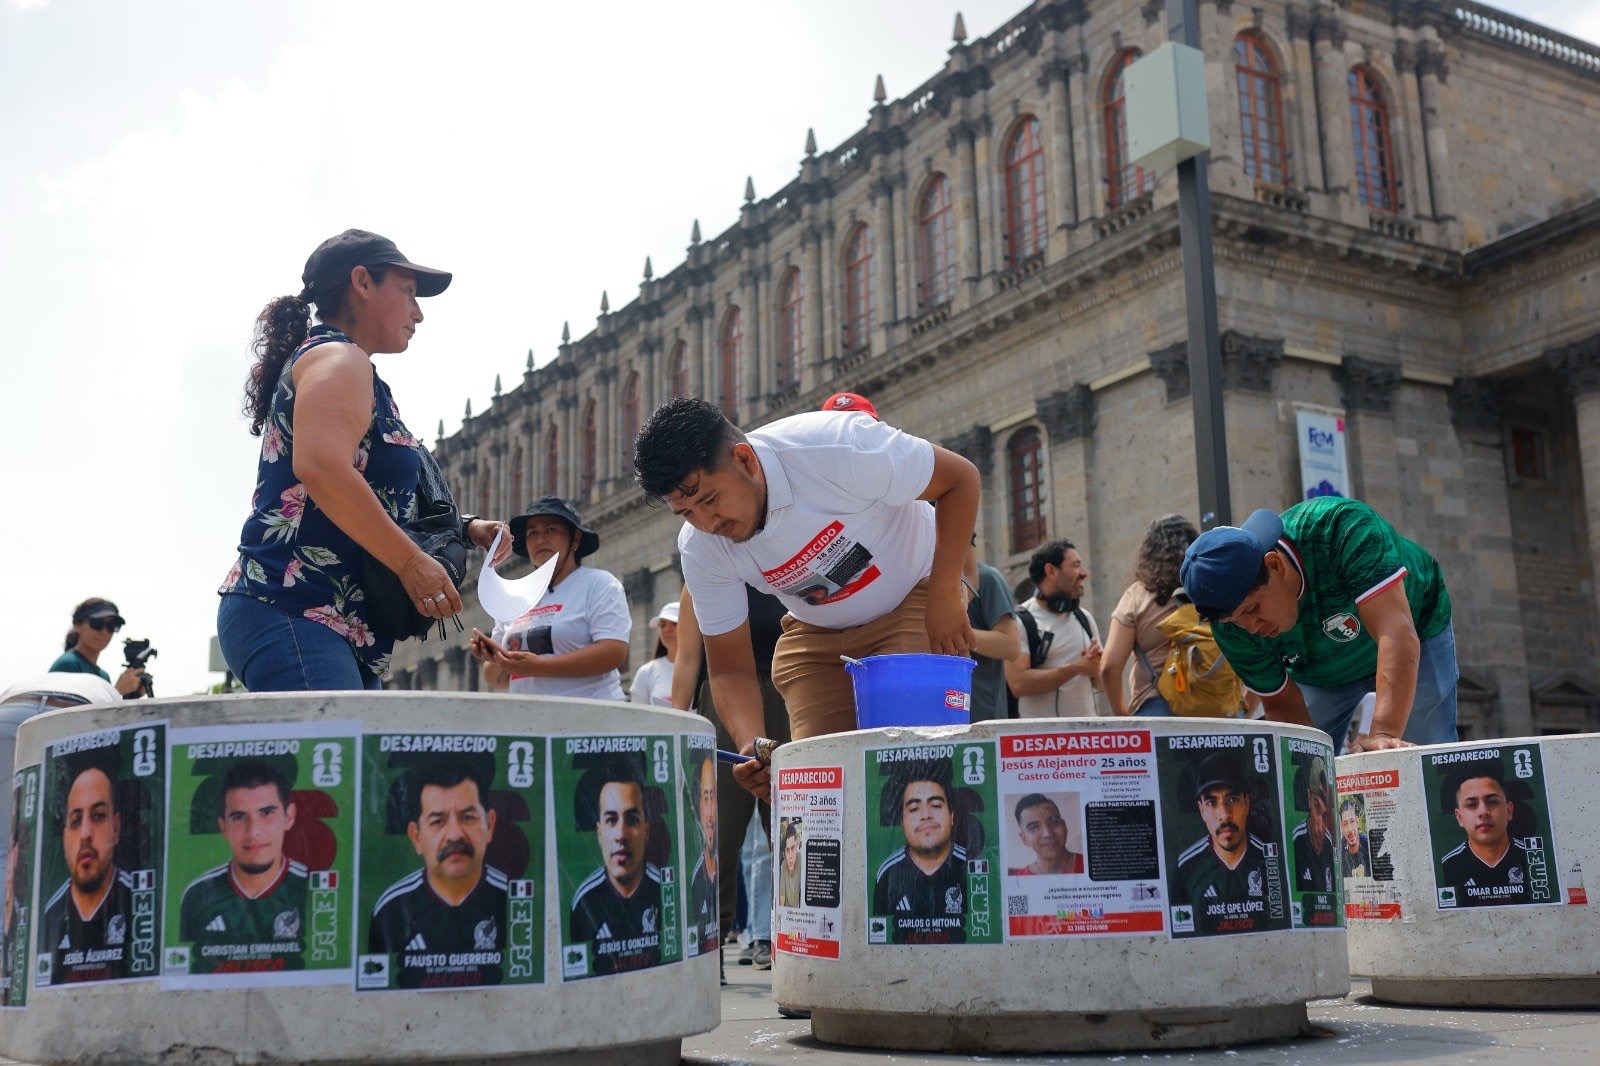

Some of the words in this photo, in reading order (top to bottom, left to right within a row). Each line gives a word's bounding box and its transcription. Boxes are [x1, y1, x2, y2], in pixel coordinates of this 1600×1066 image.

[764, 527, 837, 583] DESAPARECIDO
[817, 552, 828, 561] 18
[827, 535, 846, 553] años
[52, 731, 121, 758] DESAPARECIDO
[187, 740, 299, 760] DESAPARECIDO
[380, 736, 497, 753] DESAPARECIDO
[565, 736, 647, 754] DESAPARECIDO
[1012, 735, 1142, 752] DESAPARECIDO
[1169, 735, 1245, 750] DESAPARECIDO
[876, 744, 954, 763] DESAPARECIDO
[1431, 749, 1500, 765] DESAPARECIDO
[1001, 758, 1034, 773] Jesús
[1037, 756, 1097, 770] Alejandro
[1101, 758, 1115, 767] 25
[1118, 757, 1147, 767] años
[781, 771, 836, 785] DESAPARECIDO
[1018, 772, 1050, 781] Castro
[1053, 770, 1086, 780] Gómez
[810, 795, 818, 806] 23
[819, 795, 837, 806] años
[1108, 800, 1150, 808] PARTICULARES
[1265, 858, 1284, 919] MÉXICO
[1467, 887, 1491, 897] OMAR
[1493, 885, 1524, 895] GABINO
[1206, 902, 1227, 915] JOSÉ
[1227, 903, 1242, 914] GPE
[1242, 900, 1264, 912] LÓPEZ
[898, 918, 925, 928] CARLOS
[926, 919, 931, 927] G
[932, 918, 961, 927] MITOMA
[1216, 917, 1254, 931] JALISCO
[202, 944, 248, 957] CHRISTIAN
[249, 942, 301, 954] EMMANUEL
[597, 939, 621, 954] JESÚS
[621, 941, 627, 950] E
[627, 934, 659, 949] GONZÁLEZ
[62, 950, 85, 965] JESÚS
[85, 948, 124, 963] ÁLVAREZ
[404, 954, 446, 967] FAUSTO
[449, 952, 502, 965] GUERRERO
[212, 958, 285, 974] JALISCO
